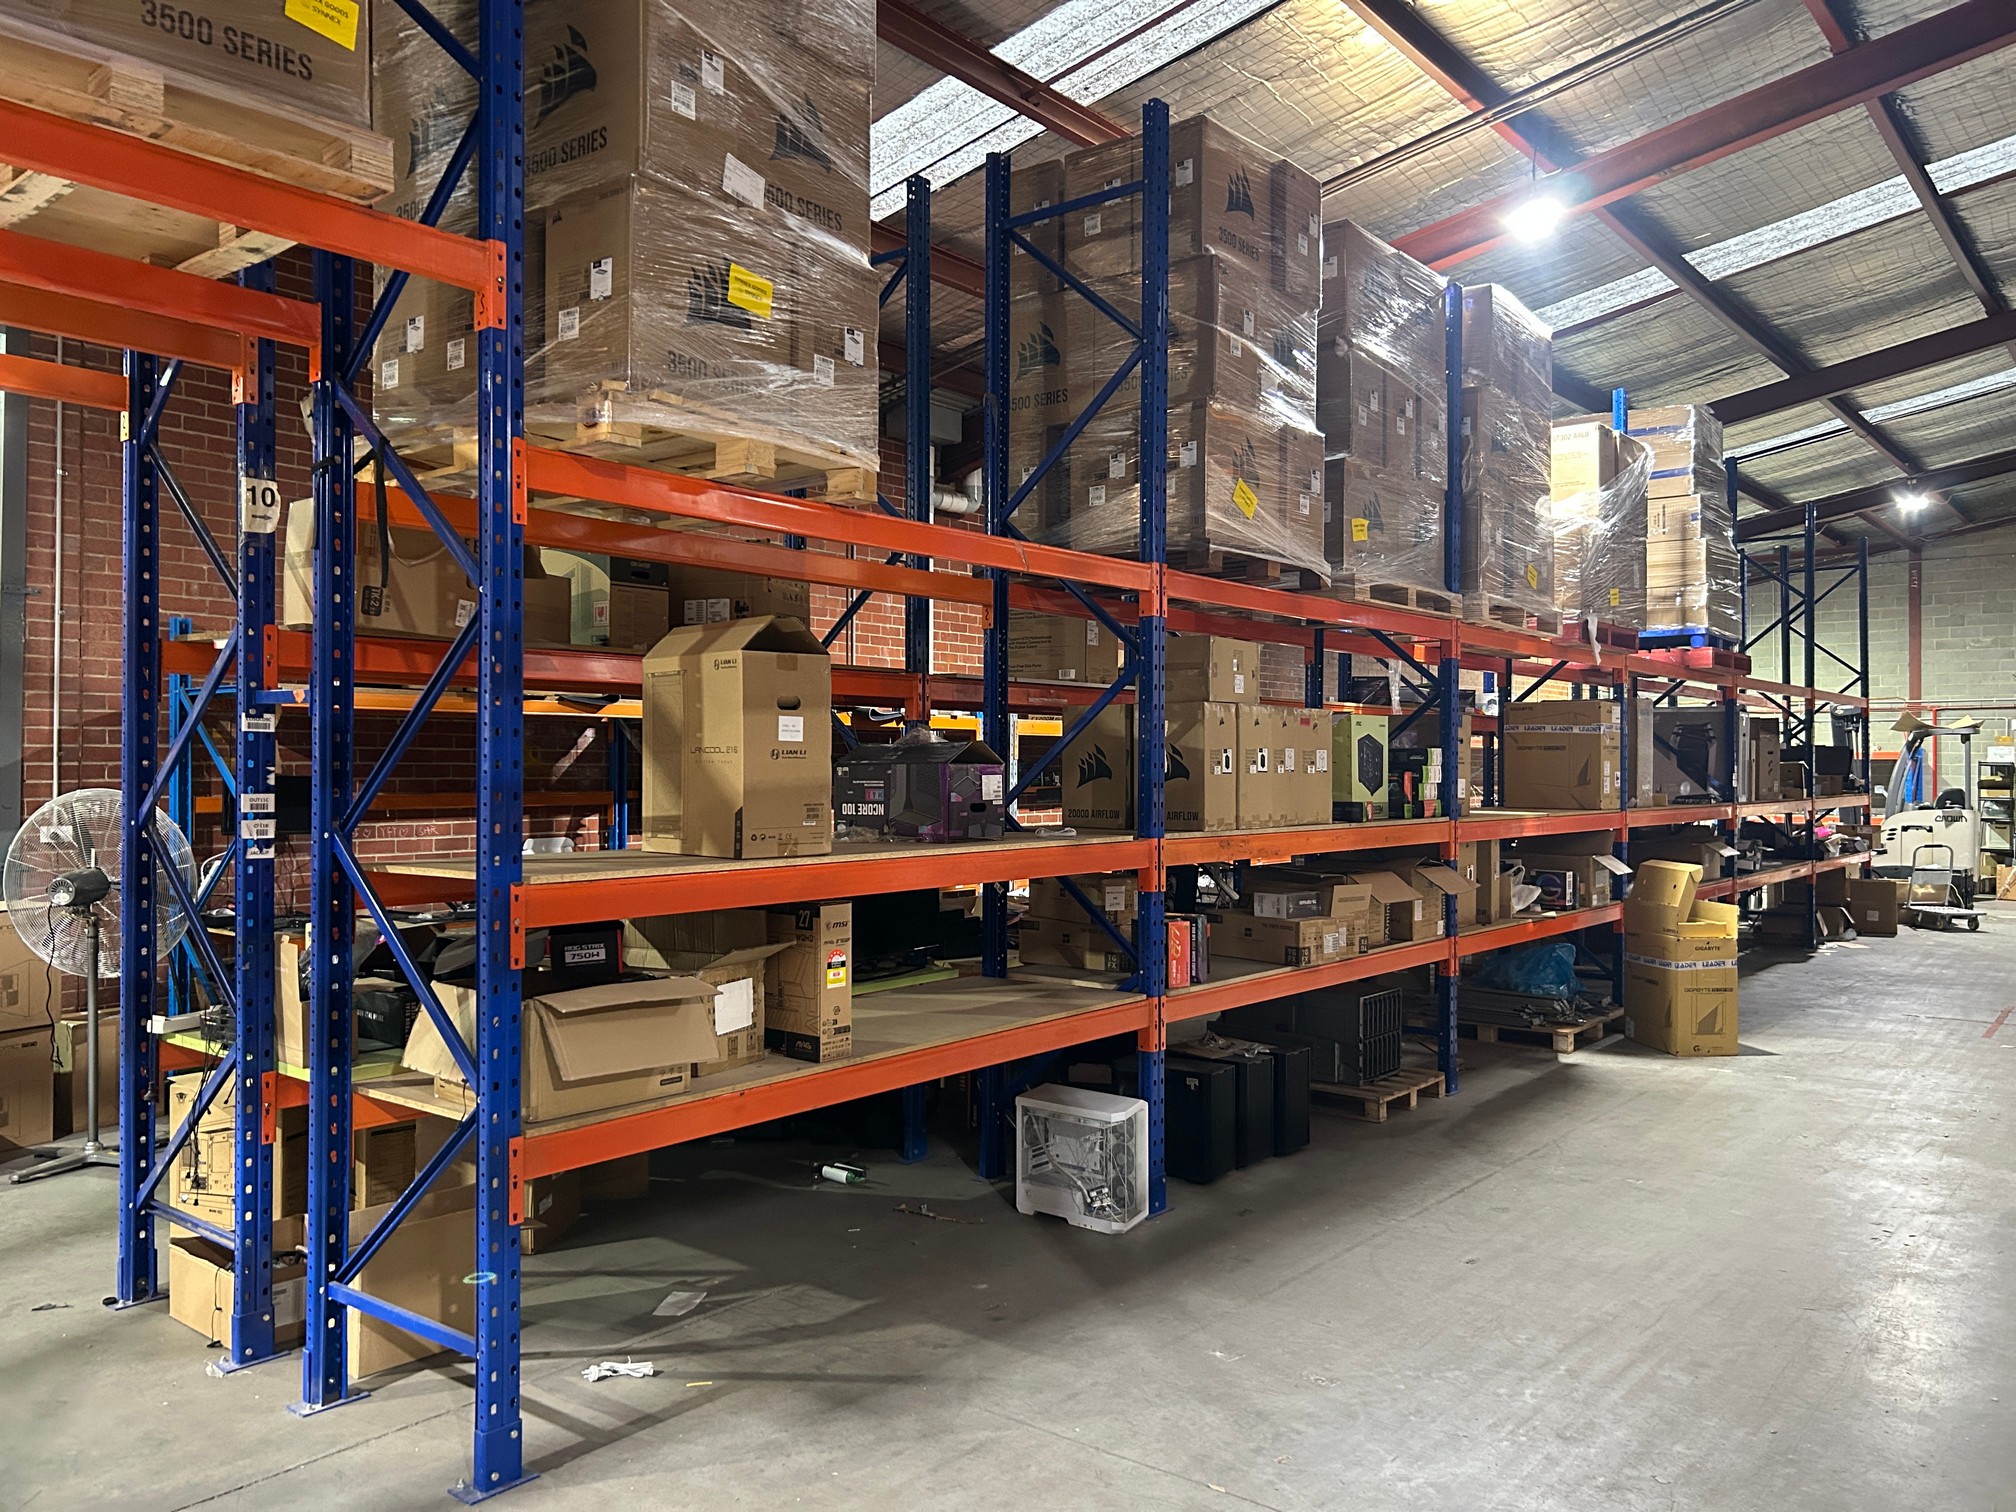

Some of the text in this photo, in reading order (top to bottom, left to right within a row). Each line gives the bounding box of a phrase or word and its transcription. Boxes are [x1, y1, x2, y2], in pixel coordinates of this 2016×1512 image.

[141, 0, 314, 81] 3500 SERIES
[561, 126, 608, 164] SERIES
[797, 197, 843, 232] SERIES
[1218, 226, 1237, 249] 3500
[1010, 388, 1069, 412] 500 SERIES
[246, 485, 276, 508] 10
[690, 746, 725, 754] LANCOOL
[841, 803, 885, 816] NCORE 100
[1090, 809, 1120, 819] AIRFLOW
[1166, 811, 1199, 821] AIRFLOW
[1934, 814, 1968, 823] CROWN
[799, 909, 811, 928] 27
[832, 920, 849, 929] msi
[570, 951, 600, 961] 750W
[1107, 954, 1117, 962] TG
[1702, 960, 1726, 968] LEADER
